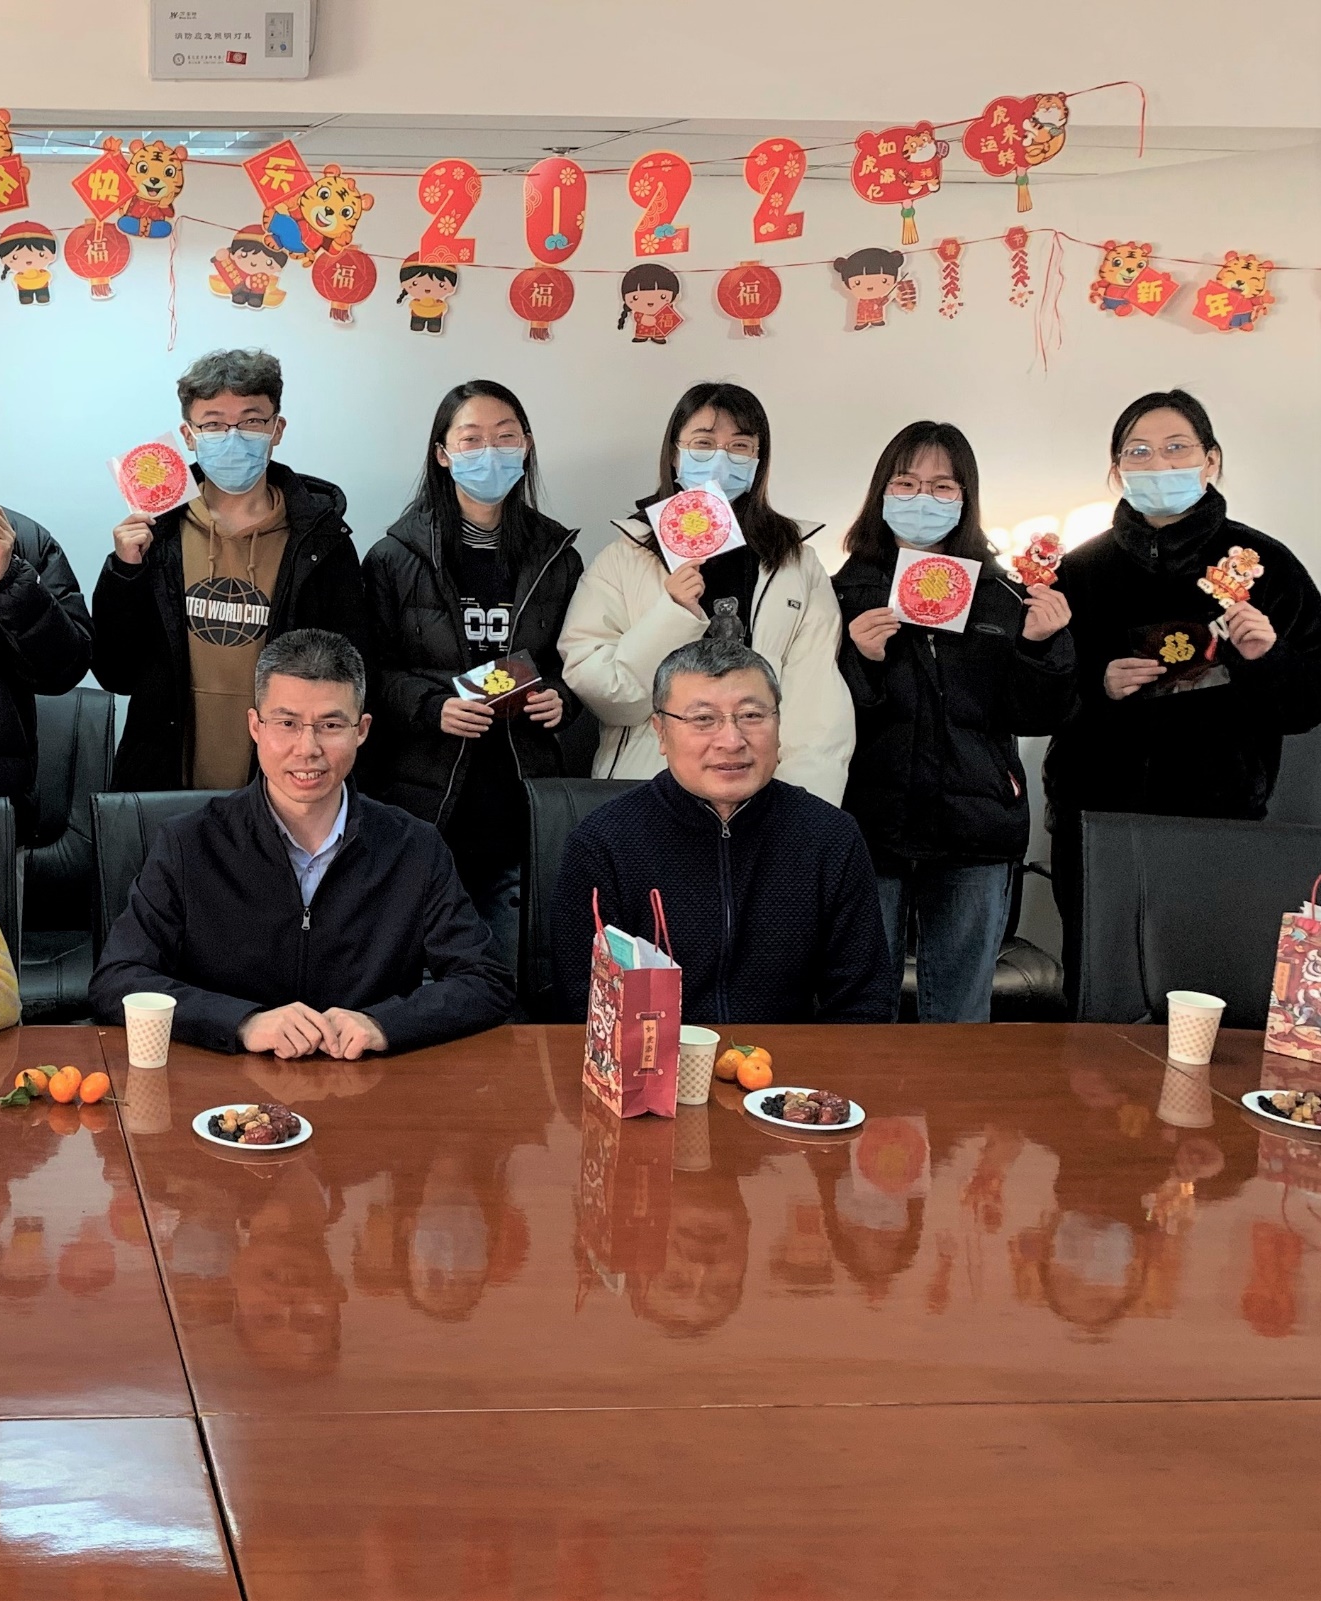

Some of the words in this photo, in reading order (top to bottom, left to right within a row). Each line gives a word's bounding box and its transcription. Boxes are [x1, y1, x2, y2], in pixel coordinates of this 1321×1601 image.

[87, 168, 120, 204] 快
[259, 155, 297, 194] 乐
[84, 238, 109, 265] 福
[331, 262, 356, 290] 福
[529, 282, 554, 308] 福
[736, 280, 761, 306] 福
[1136, 279, 1163, 305] 新
[1204, 292, 1234, 319] 年
[208, 599, 243, 623] WORLD
